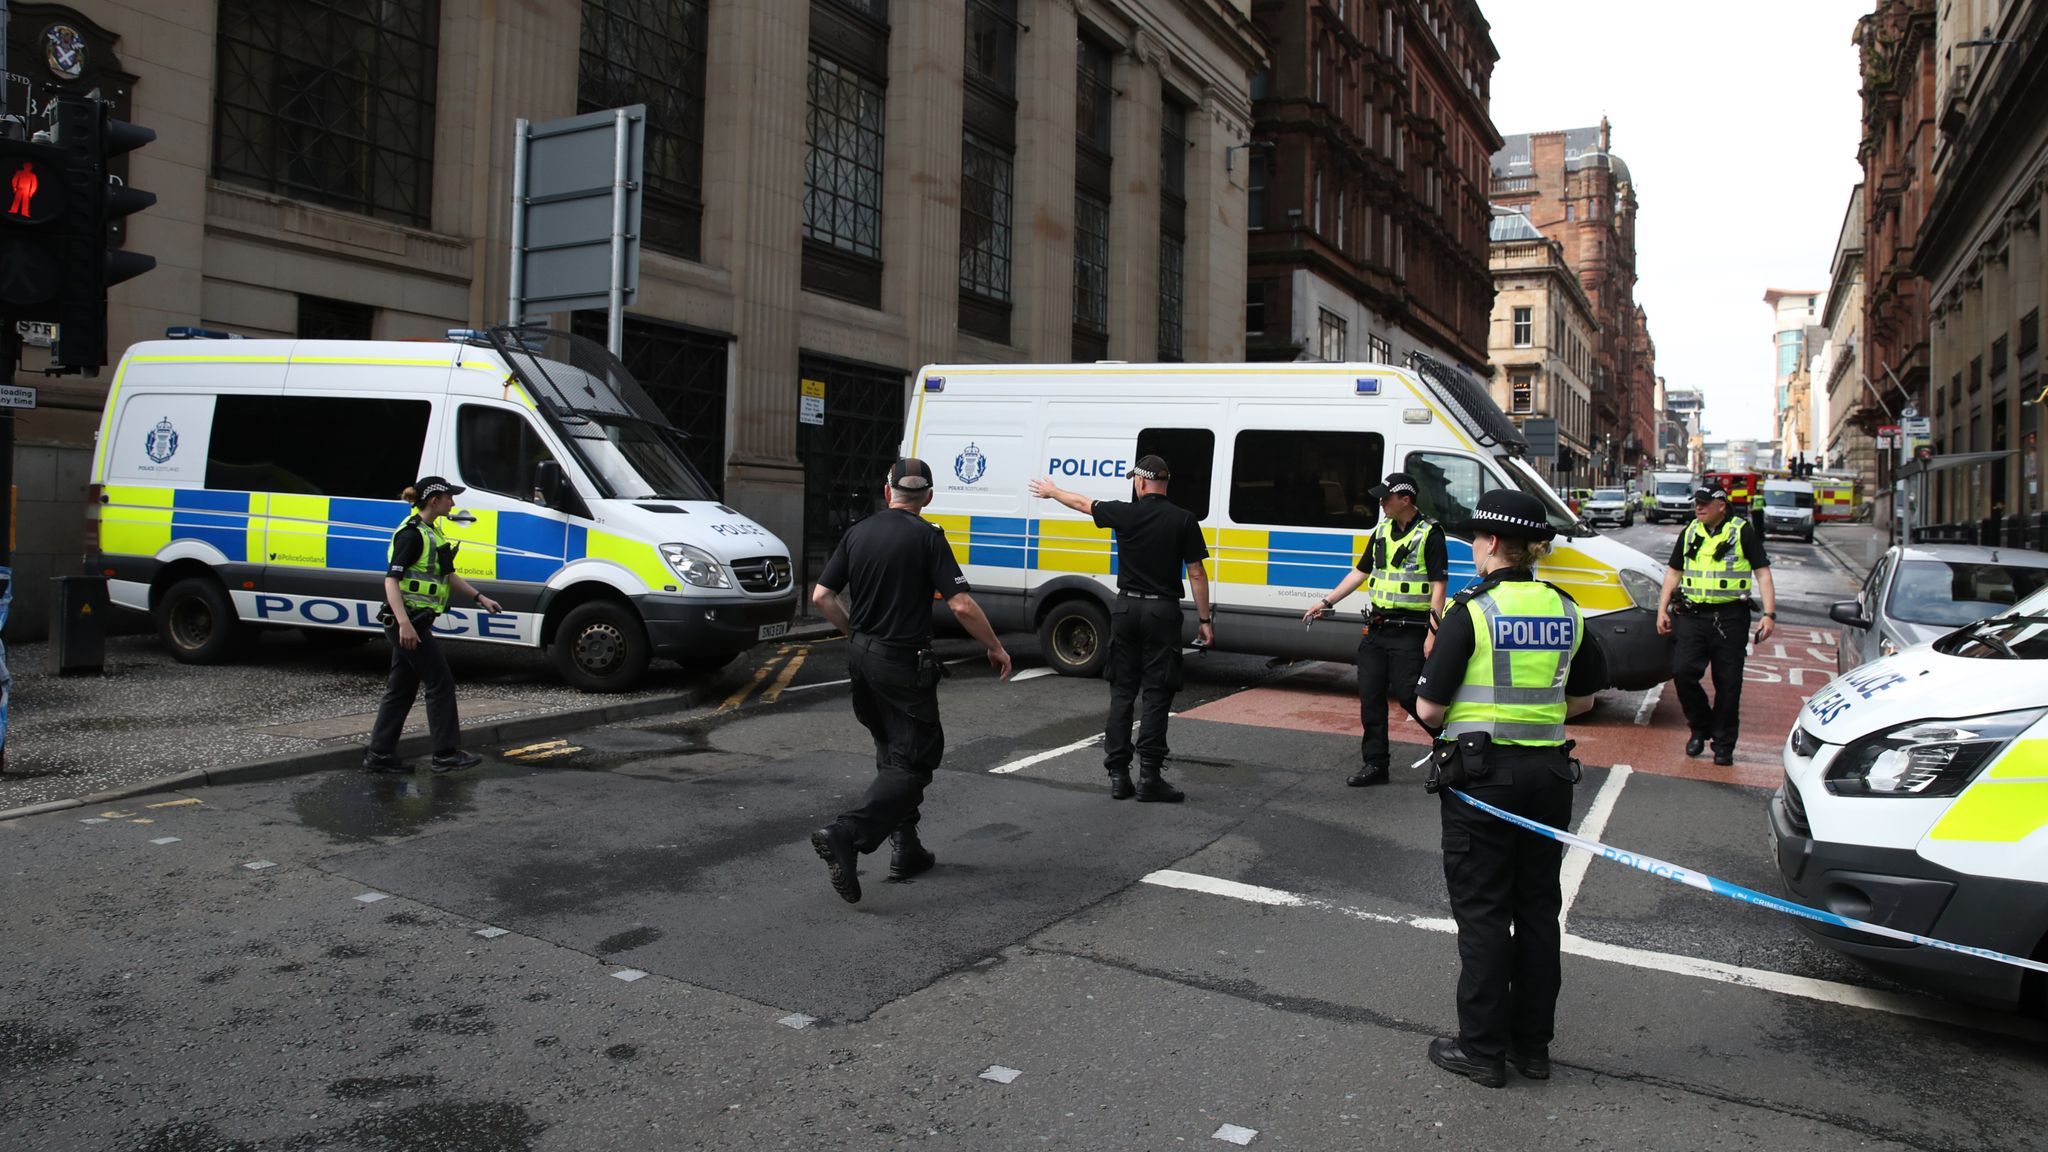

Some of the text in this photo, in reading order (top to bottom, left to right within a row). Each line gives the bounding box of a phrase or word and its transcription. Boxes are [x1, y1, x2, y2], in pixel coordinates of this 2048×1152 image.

[0, 397, 33, 405] ny time
[1, 388, 32, 398] loading
[1049, 457, 1127, 478] POLICE
[710, 524, 765, 537] POLICE
[255, 594, 522, 640] POLCE
[1498, 621, 1571, 645] POLICE
[1752, 897, 1824, 922] CRIMESTOPPERS
